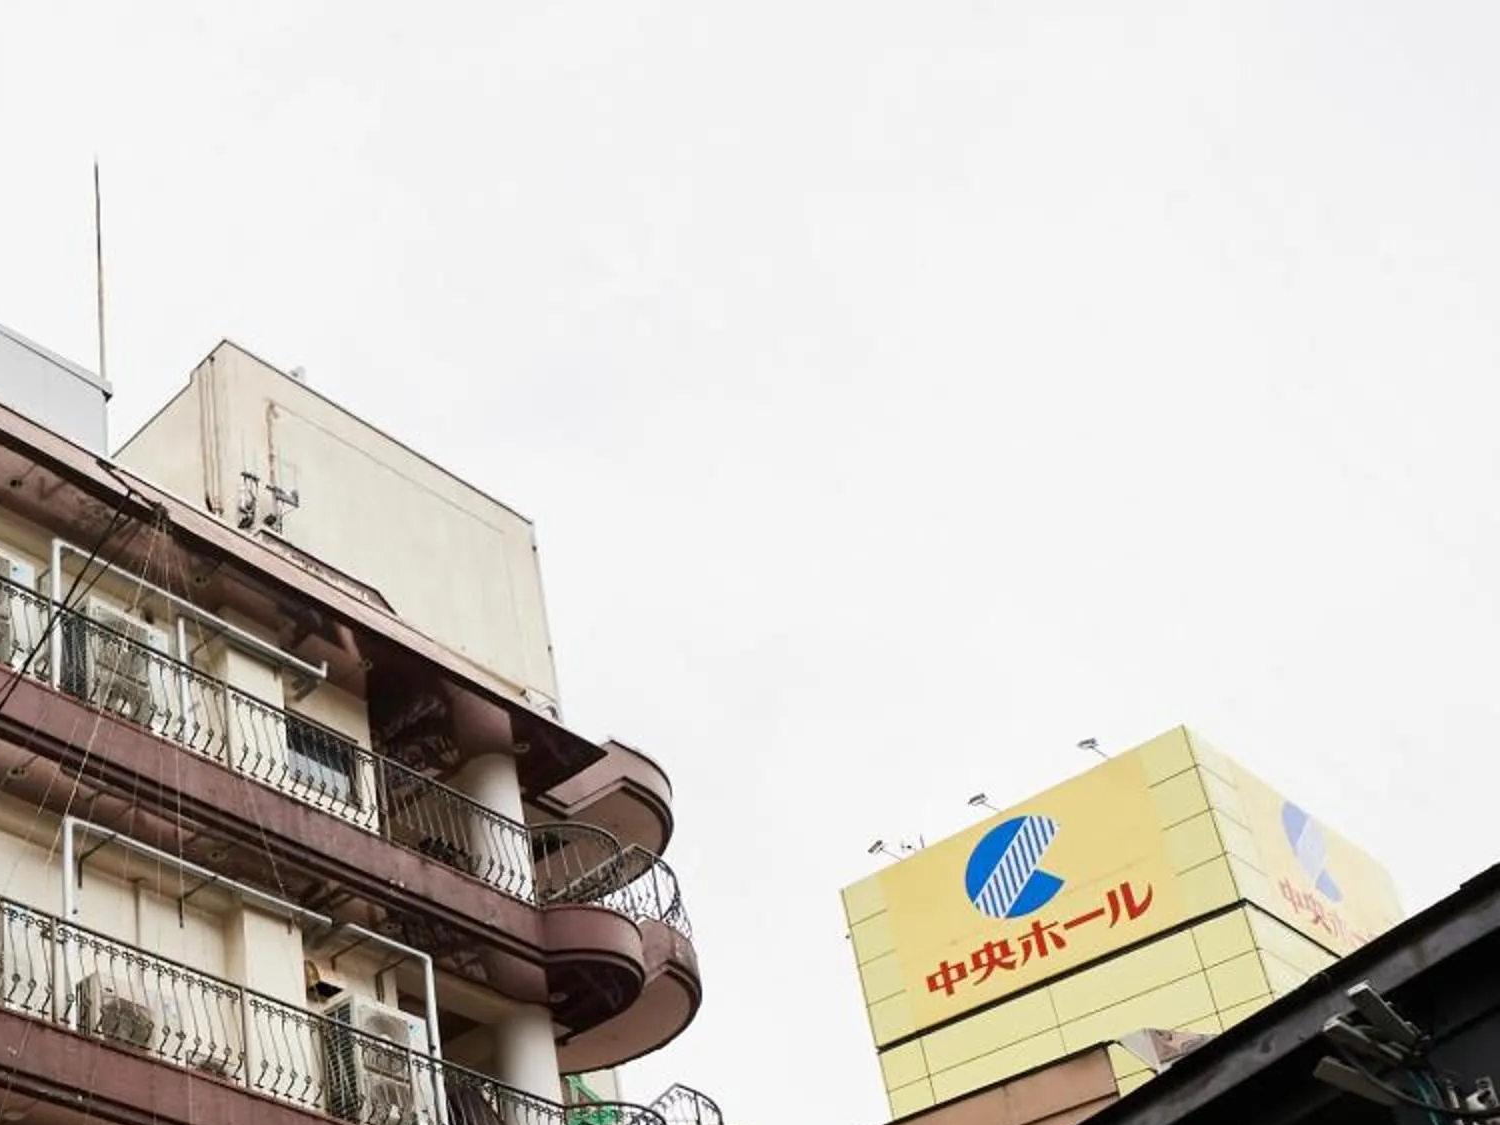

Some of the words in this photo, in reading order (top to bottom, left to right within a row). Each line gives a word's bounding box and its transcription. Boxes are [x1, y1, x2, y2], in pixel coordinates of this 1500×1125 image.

[926, 881, 1153, 997] 中央ホール
